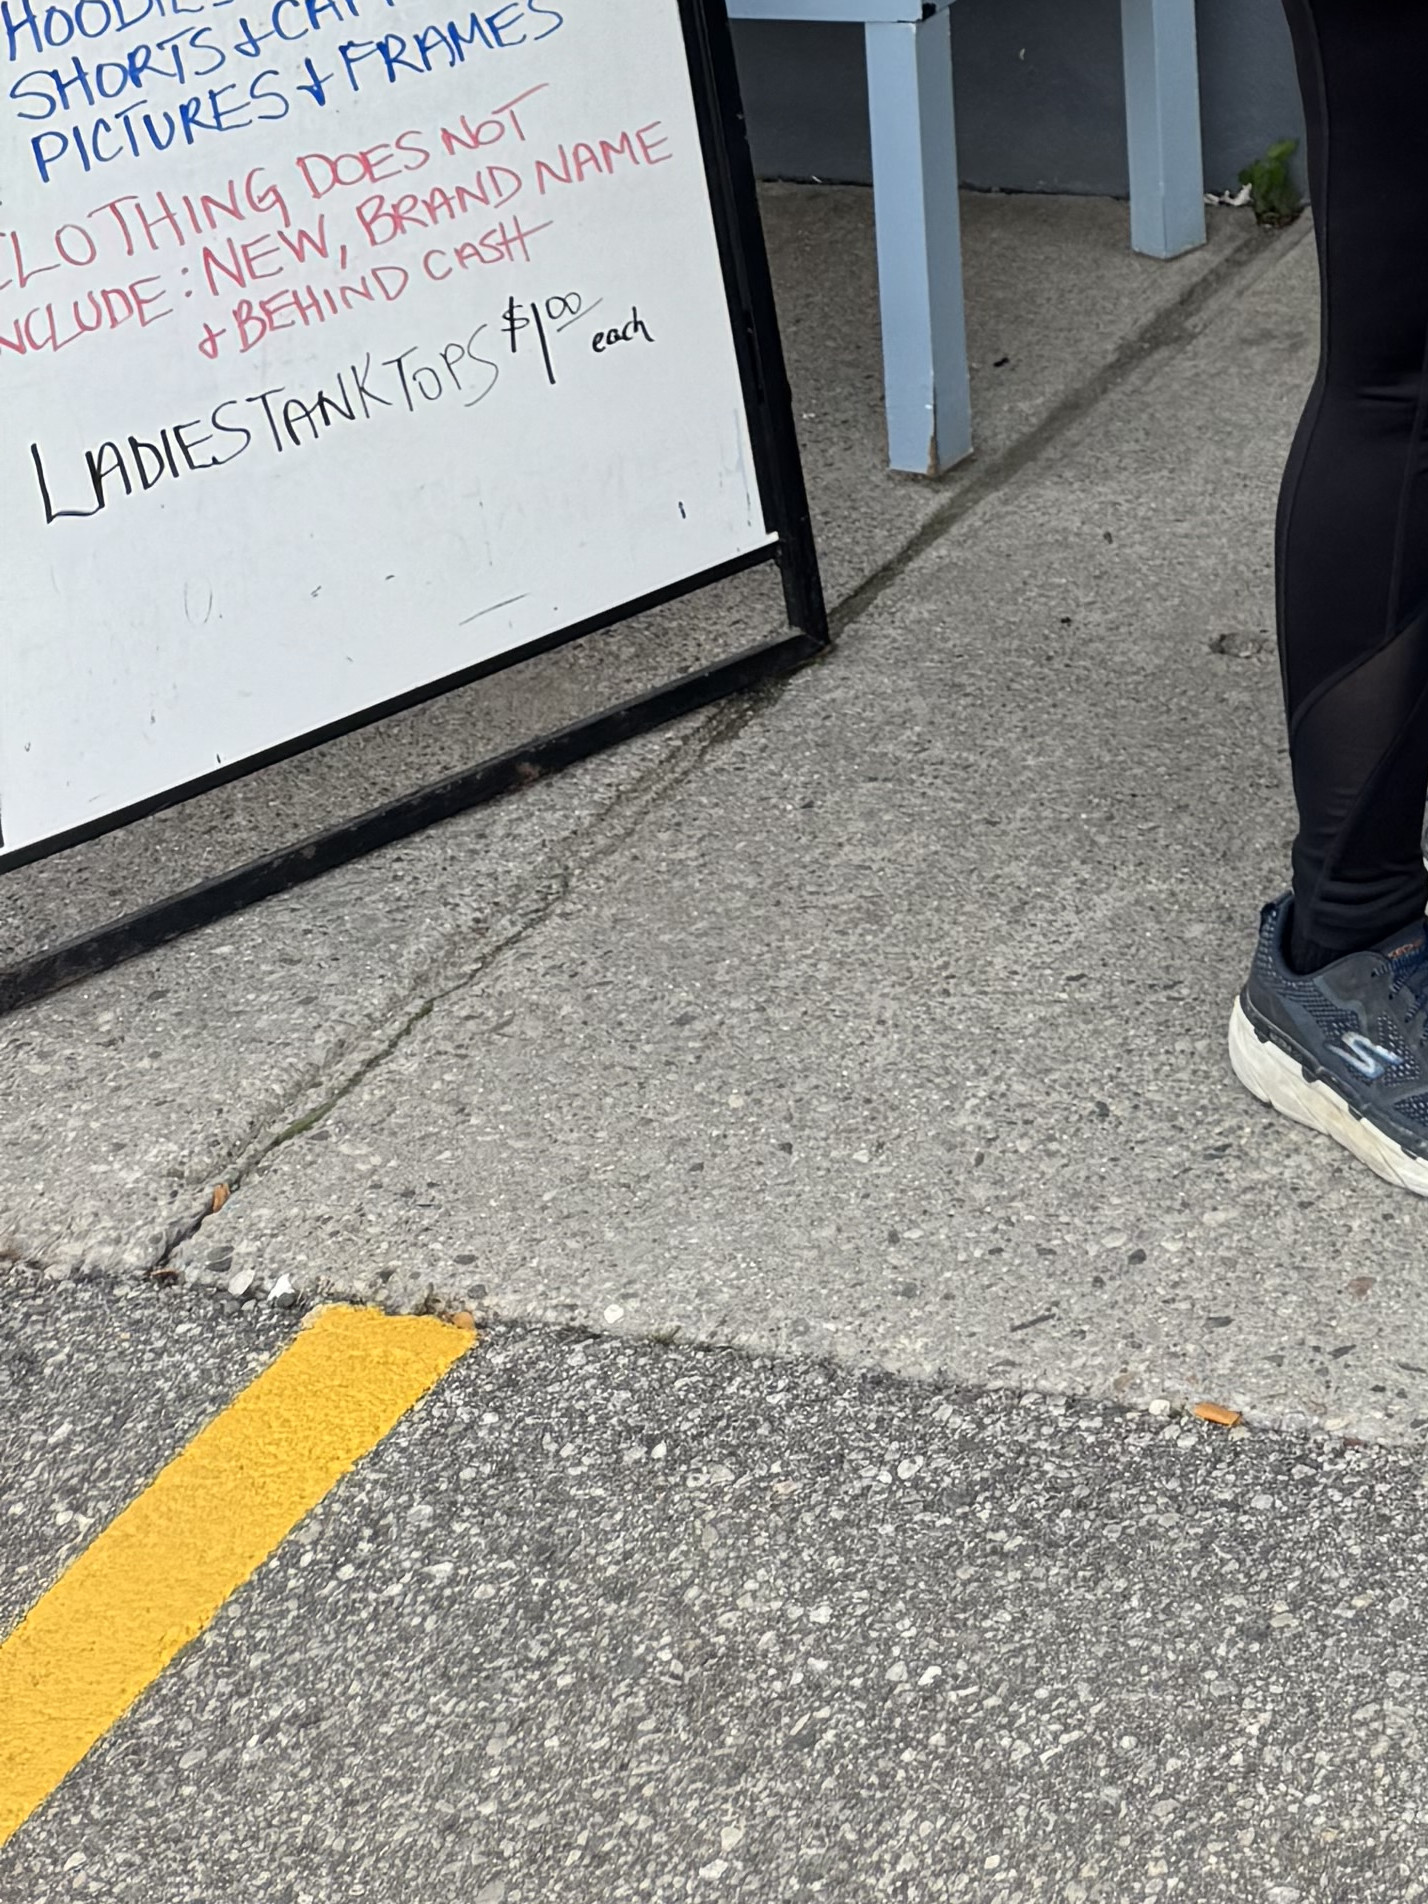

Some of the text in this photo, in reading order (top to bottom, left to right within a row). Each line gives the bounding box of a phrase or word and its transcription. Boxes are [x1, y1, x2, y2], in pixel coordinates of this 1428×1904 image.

[9, 26, 227, 120] SHORTS
[31, 70, 290, 183] PICTURES
[296, 130, 431, 199] DOES
[441, 83, 549, 156] NOT
[203, 214, 347, 295] NEW,
[356, 165, 522, 247] BRAND
[535, 121, 673, 194] NAME
[232, 265, 409, 354] BEHIND
[423, 215, 554, 281] CASH
[31, 400, 251, 524] LADIES
[246, 352, 393, 452] TANK
[382, 323, 499, 412] TOPS
[592, 306, 655, 353] each
